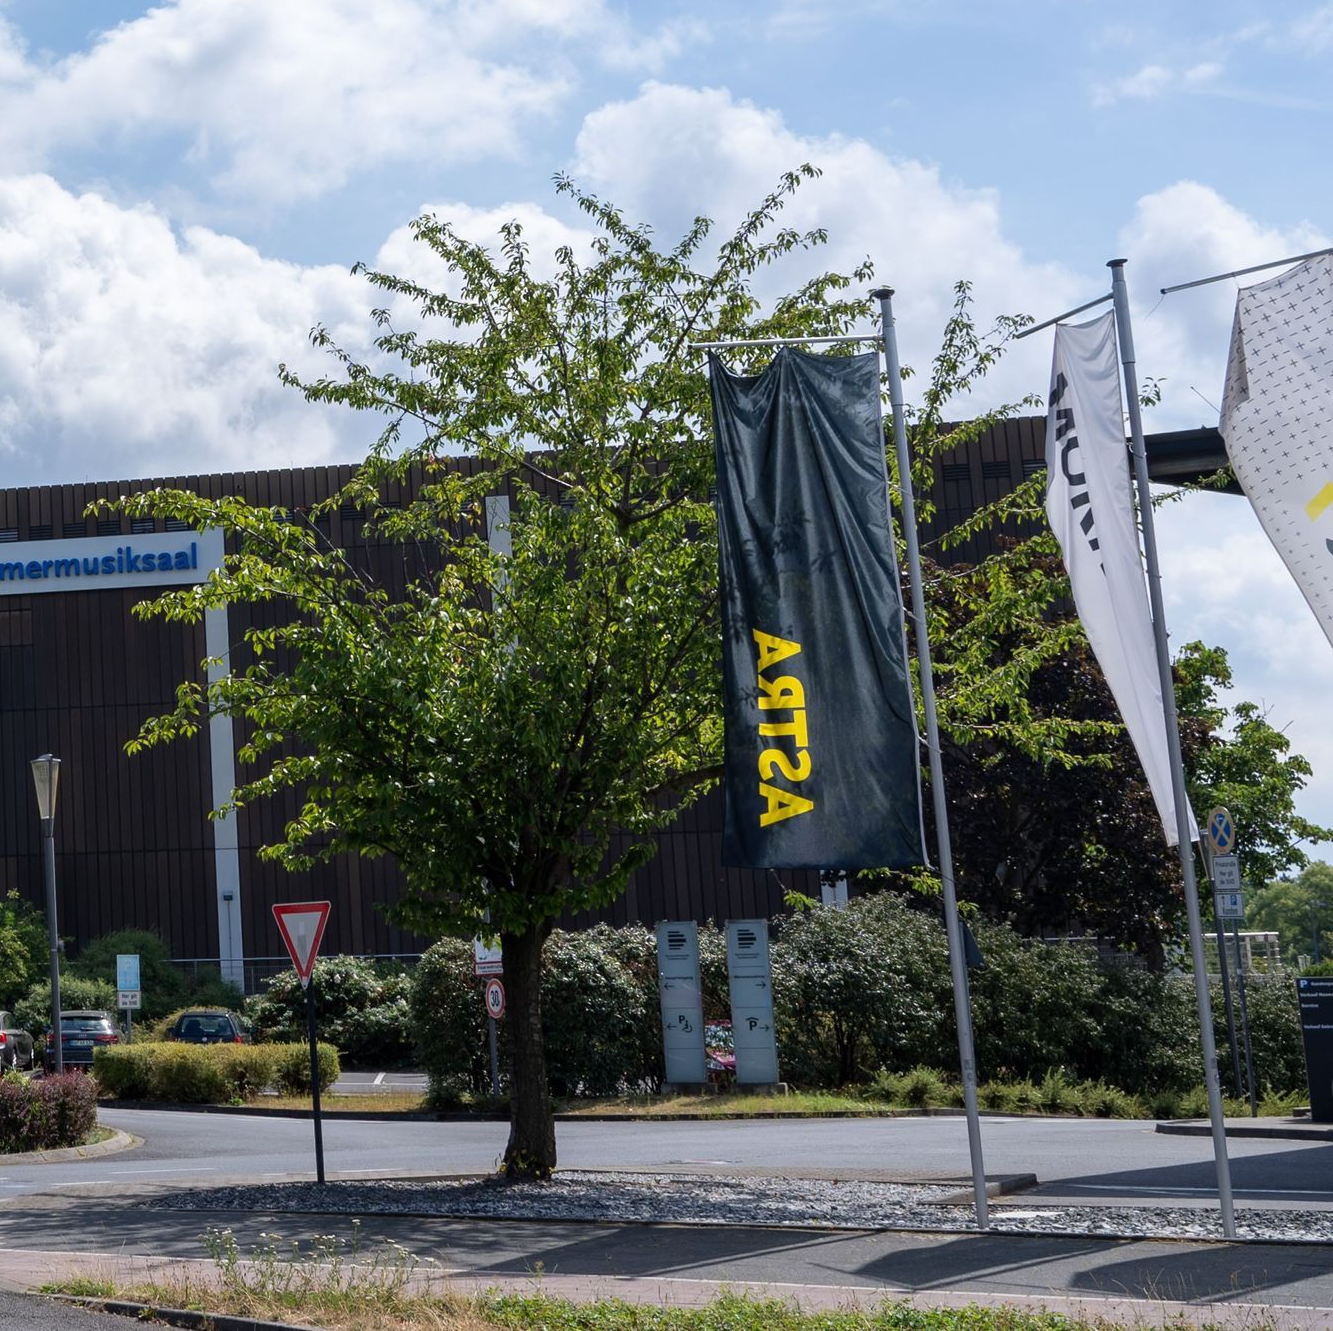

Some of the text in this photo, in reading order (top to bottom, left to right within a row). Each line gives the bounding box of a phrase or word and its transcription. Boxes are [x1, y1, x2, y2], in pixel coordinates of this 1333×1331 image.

[1300, 980, 1307, 988] P
[491, 990, 500, 1007] 30
[679, 1015, 686, 1023] P
